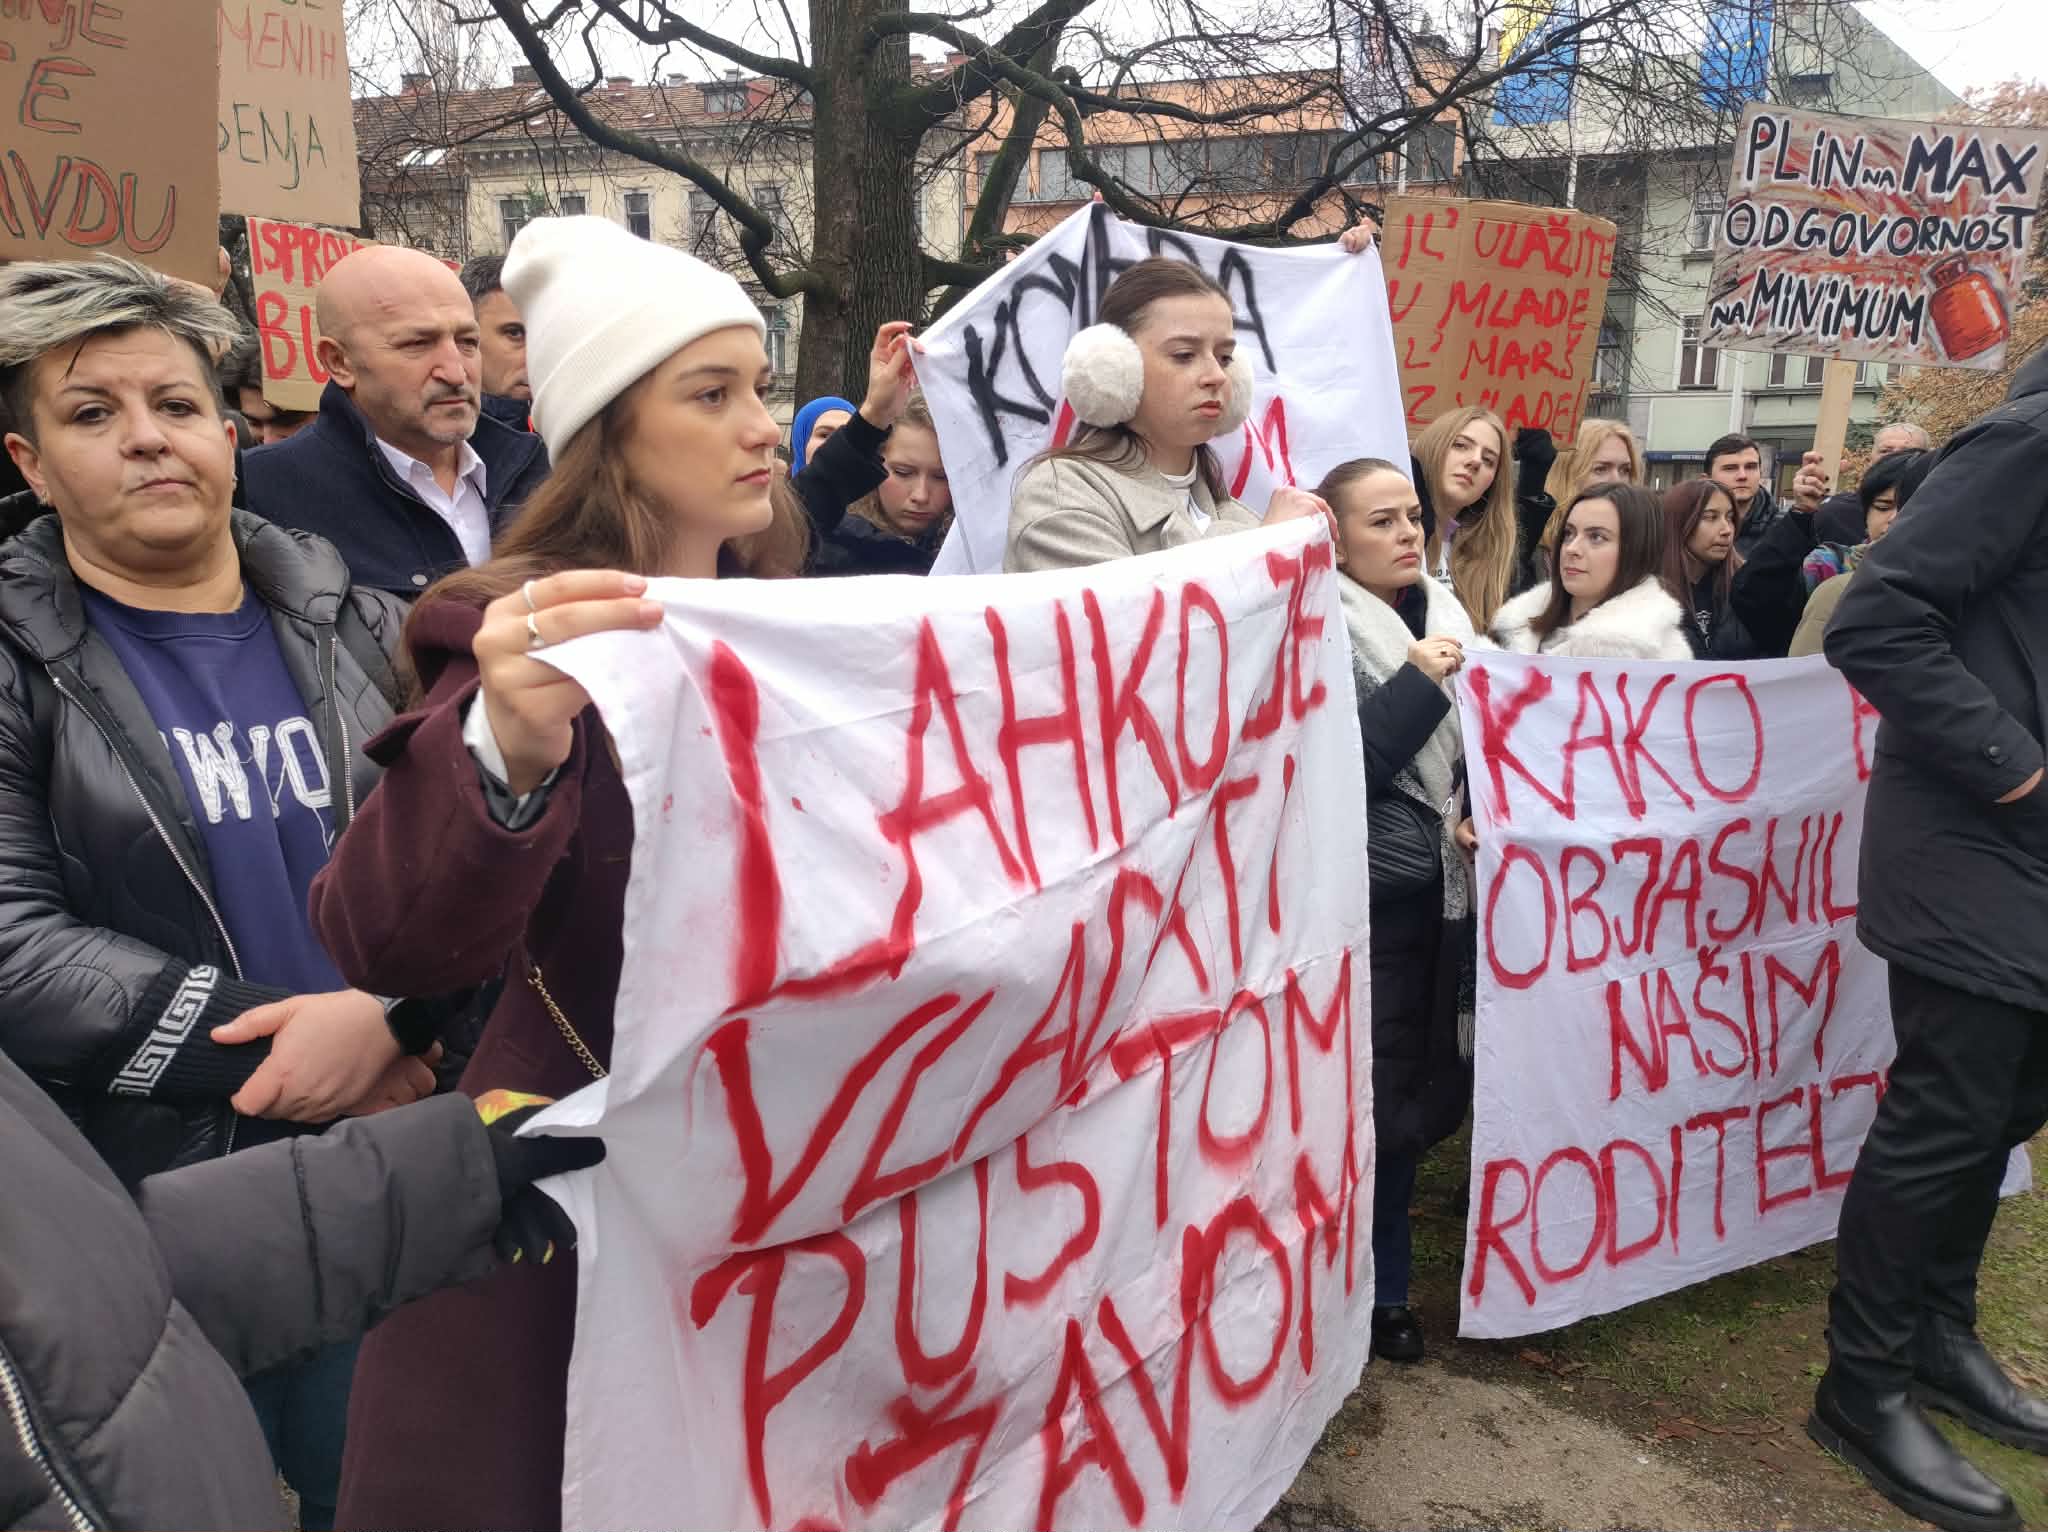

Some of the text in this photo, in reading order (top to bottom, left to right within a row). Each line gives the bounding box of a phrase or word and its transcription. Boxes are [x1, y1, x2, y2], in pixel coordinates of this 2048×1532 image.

[1862, 168, 1896, 189] NA
[1902, 134, 2038, 196] MAX
[1475, 214, 1617, 279] ULAŽITE
[1726, 202, 2038, 257] ODGOVORNOST
[1436, 280, 1590, 331] MLADE
[1710, 301, 1745, 329] NA
[1460, 333, 1583, 381] MARŠ
[1467, 664, 1765, 822] KAKO
[710, 541, 1334, 1014] LAHKO JE
[1608, 940, 1840, 1100] NAŠIM
[690, 943, 1360, 1527] PUSTOM
[786, 1152, 1358, 1532] ŽAVOM
